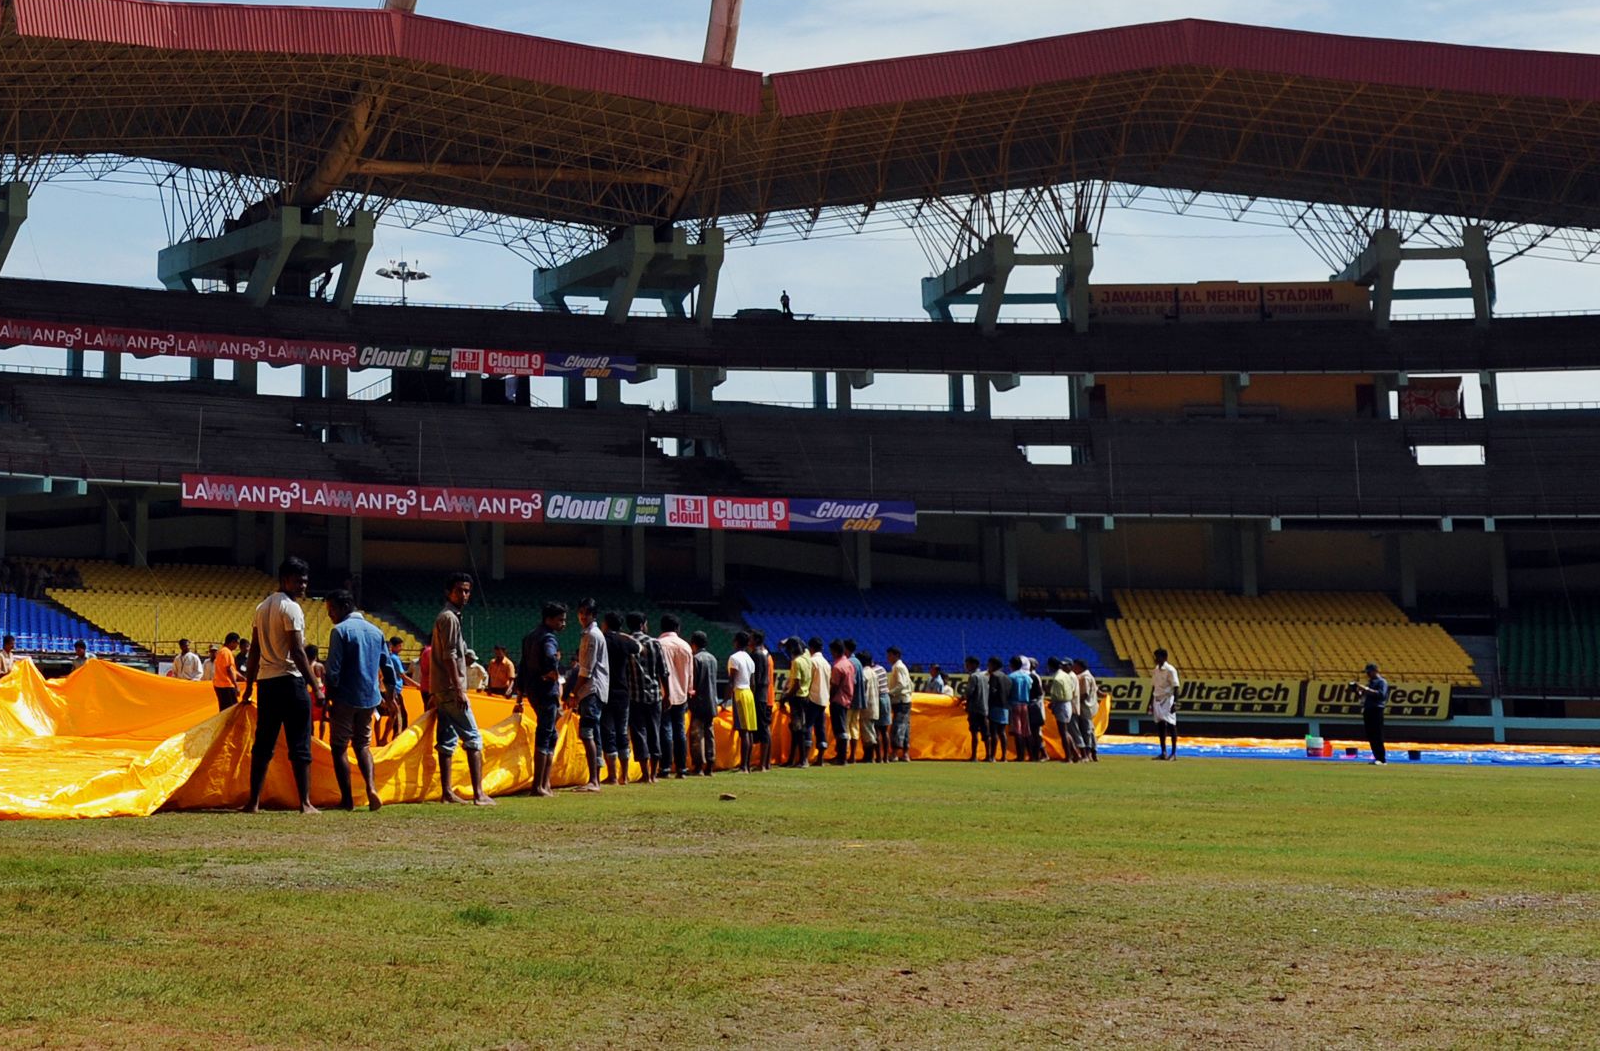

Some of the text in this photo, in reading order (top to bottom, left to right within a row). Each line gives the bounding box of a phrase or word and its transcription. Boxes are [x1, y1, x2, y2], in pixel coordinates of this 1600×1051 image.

[1206, 290, 1257, 302] NEHRU
[1267, 288, 1333, 301] STADIUM
[359, 347, 410, 367] Cloud
[487, 352, 529, 368] Cloud
[547, 495, 628, 520] Cloud 9
[685, 498, 695, 511] 9
[713, 499, 785, 520] Cloud 9
[669, 511, 704, 524] cloud
[842, 518, 882, 530] cola
[1321, 705, 1433, 715] CEENT
